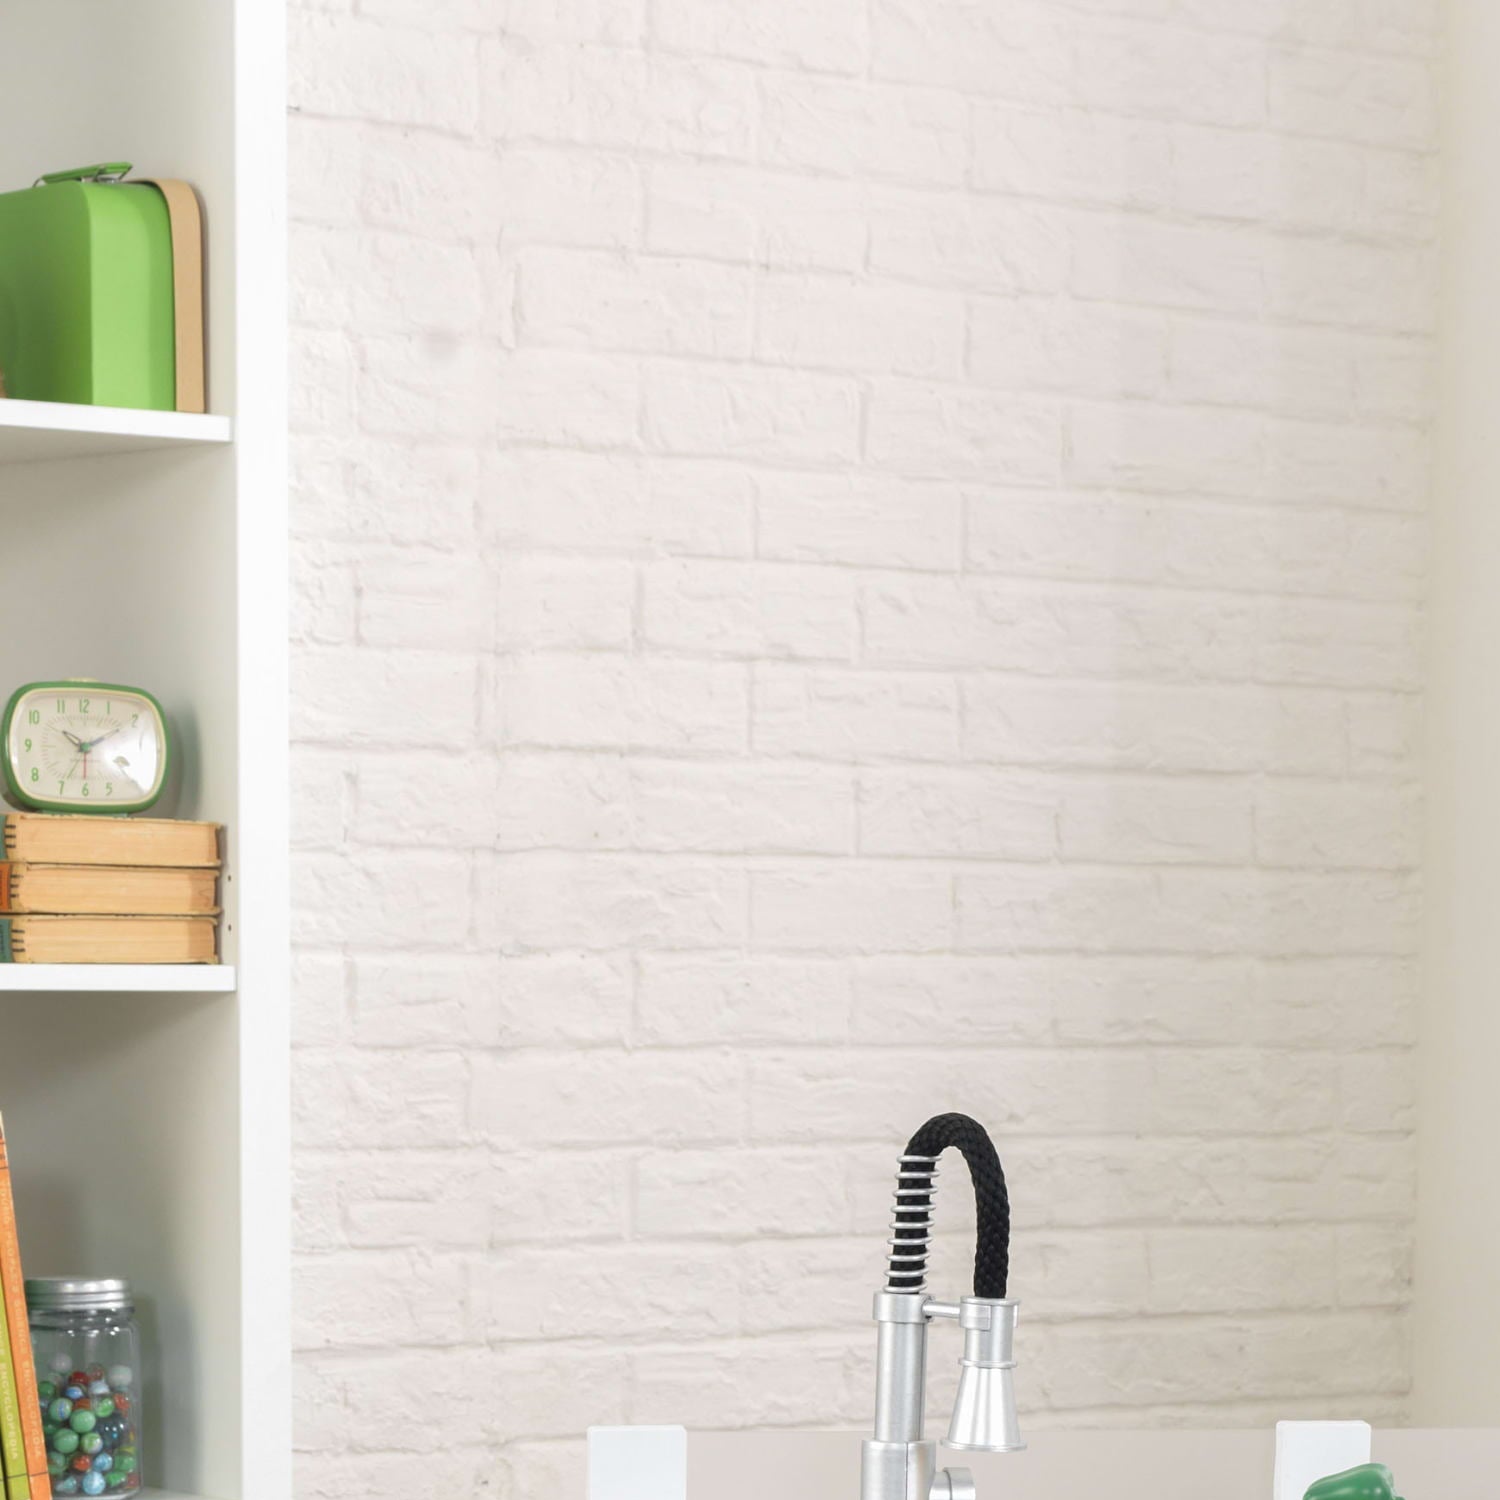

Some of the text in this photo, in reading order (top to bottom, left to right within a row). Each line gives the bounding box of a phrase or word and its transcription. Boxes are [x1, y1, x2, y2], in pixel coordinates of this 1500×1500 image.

[57, 699, 65, 714] 11
[79, 698, 90, 714] 12
[106, 700, 111, 715] 1
[28, 709, 40, 725] 10
[131, 713, 139, 728] 2
[24, 738, 32, 752] 9
[31, 767, 39, 782] 8
[57, 780, 65, 795] 7
[81, 782, 89, 797] 6
[105, 782, 113, 796] 5
